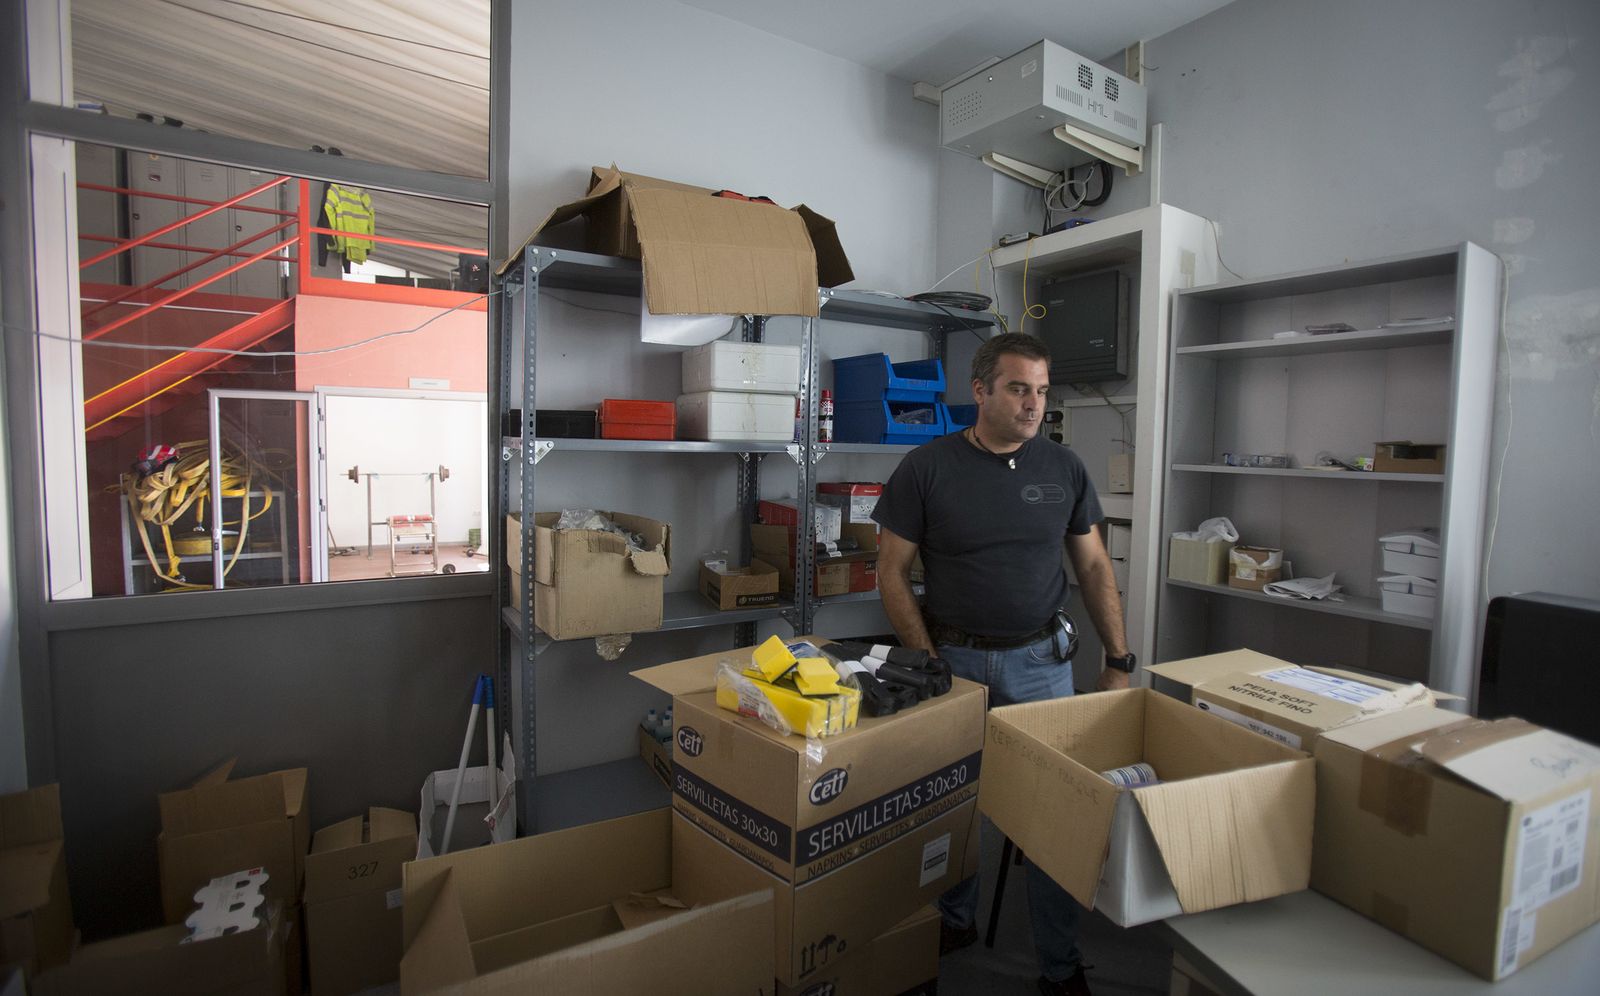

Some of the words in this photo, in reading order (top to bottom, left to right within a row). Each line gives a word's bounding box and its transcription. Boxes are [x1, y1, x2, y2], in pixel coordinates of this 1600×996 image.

[1228, 685, 1275, 703] NITRILE
[1278, 701, 1313, 714] FINO
[1242, 682, 1278, 697] PEHA
[1279, 693, 1318, 707] SOFT
[676, 774, 739, 826] SERVILLETAS
[741, 813, 778, 847] 30x30
[808, 785, 922, 858] SERVILLETAS
[925, 764, 968, 802] 30x30
[347, 861, 379, 880] 327
[807, 848, 852, 880] NAPKINS
[859, 820, 911, 851] SERVIETTES
